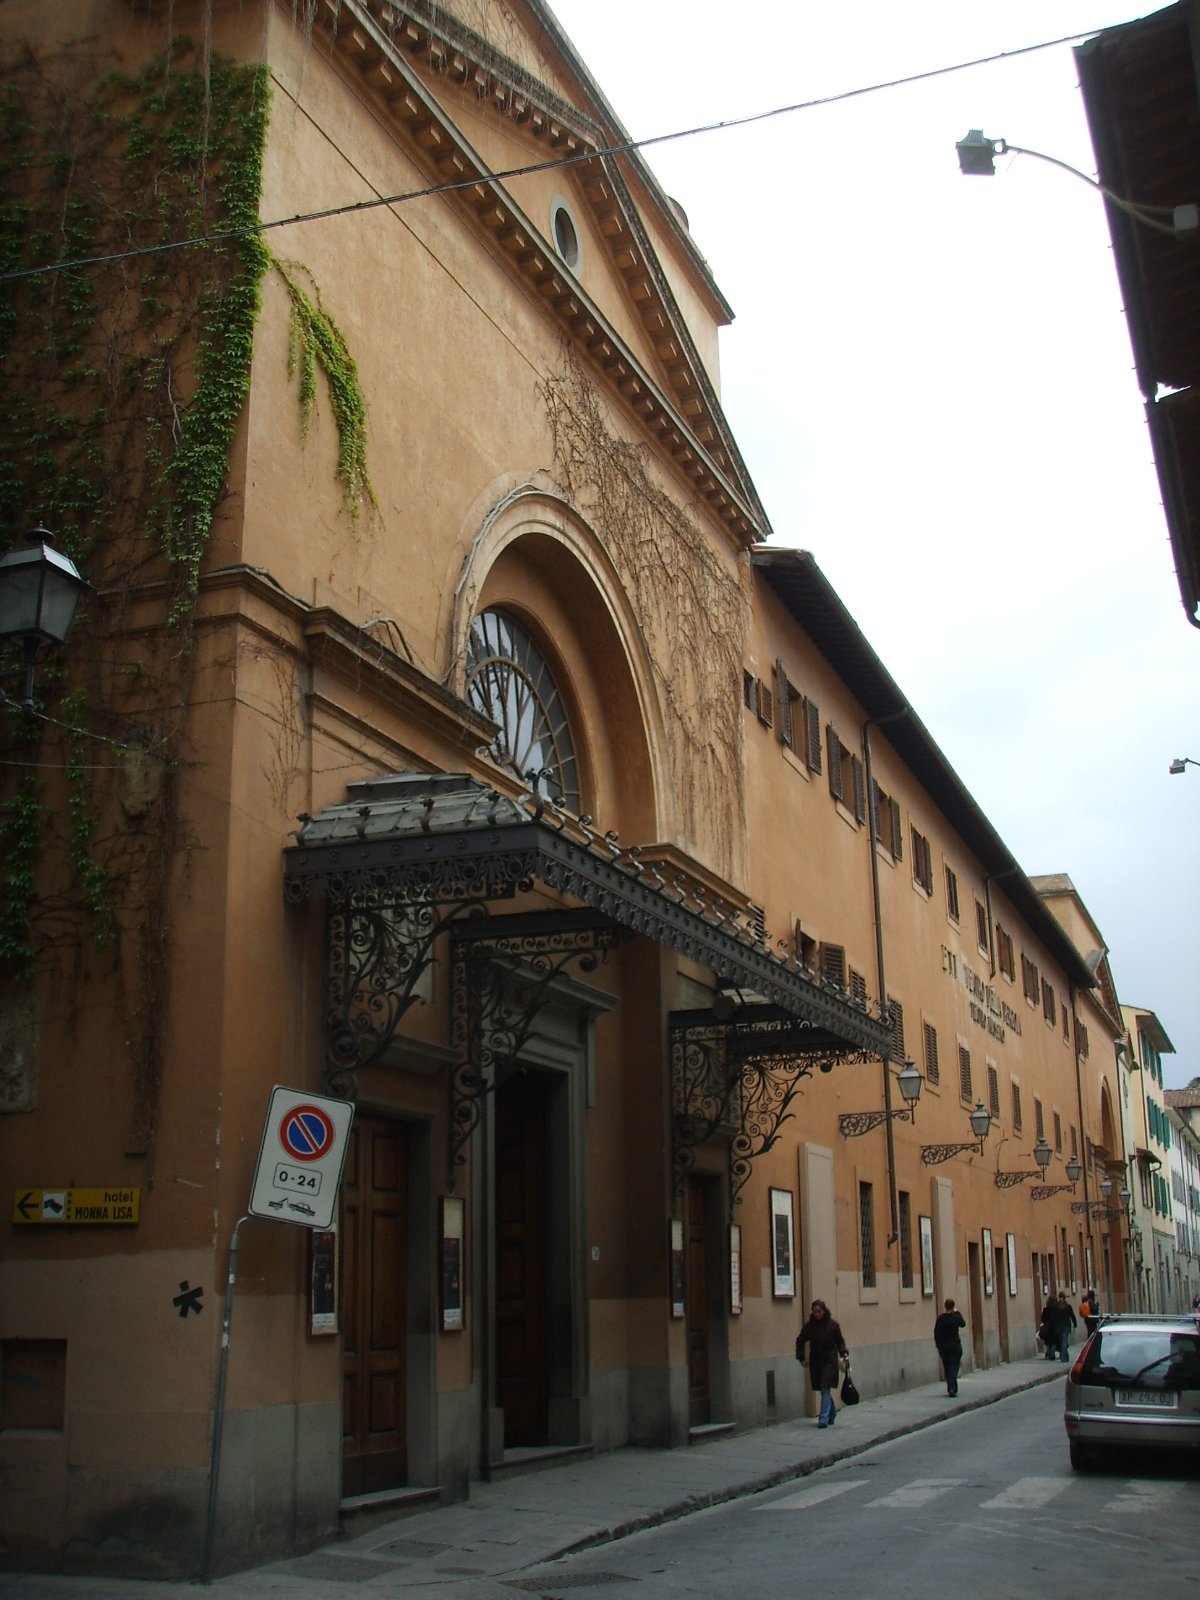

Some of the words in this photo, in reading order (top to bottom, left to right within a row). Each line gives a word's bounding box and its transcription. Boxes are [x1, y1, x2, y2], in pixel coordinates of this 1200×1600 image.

[104, 1191, 134, 1203] hotel
[75, 1206, 109, 1219] MONNA
[113, 1206, 133, 1219] LISA
[1121, 1391, 1133, 1402] AP
